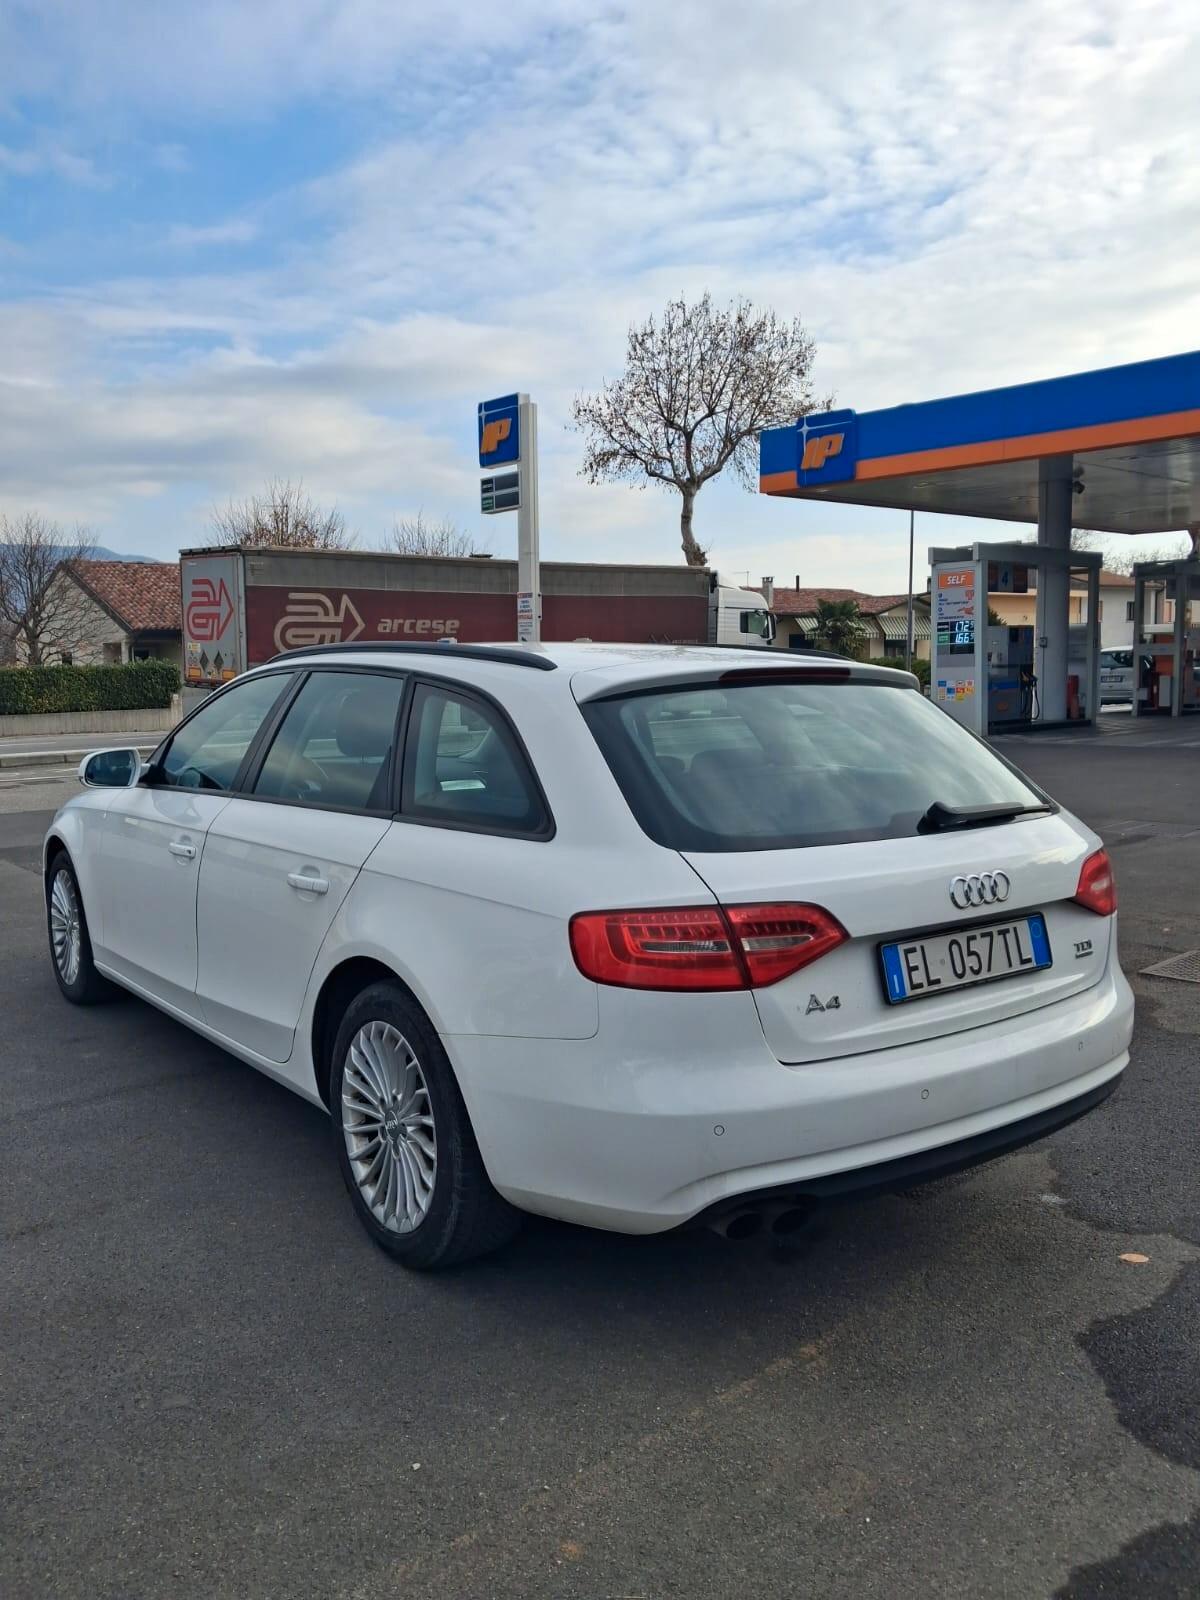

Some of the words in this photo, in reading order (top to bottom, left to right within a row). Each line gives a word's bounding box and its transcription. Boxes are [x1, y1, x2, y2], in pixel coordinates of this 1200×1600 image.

[481, 418, 512, 452] IP
[801, 433, 844, 470] IP
[947, 574, 967, 585] SELF
[377, 617, 460, 634] arcese
[904, 944, 941, 991] EL
[949, 926, 1032, 979] 057TL
[805, 994, 841, 1015] A4
